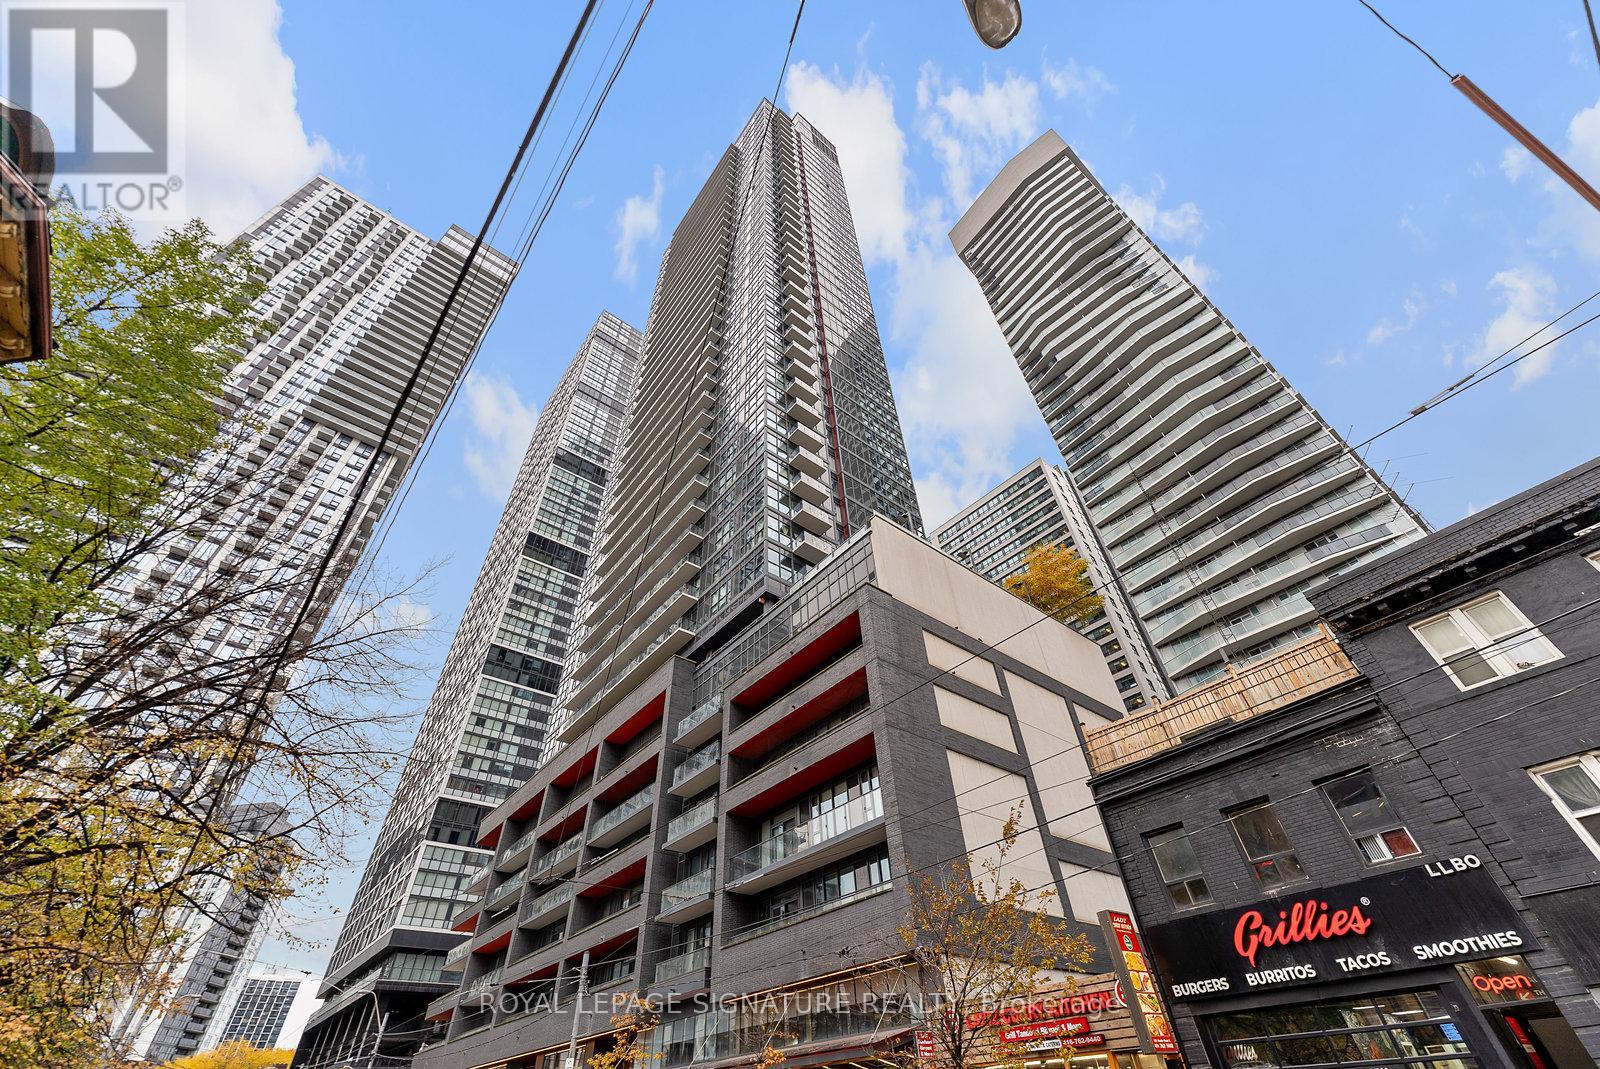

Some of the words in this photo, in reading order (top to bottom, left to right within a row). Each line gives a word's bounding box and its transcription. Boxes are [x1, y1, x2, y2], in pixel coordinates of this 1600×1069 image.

[1425, 854, 1481, 877] LLBO
[1171, 977, 1230, 997] BURGERS
[1245, 964, 1317, 986] BURRITOS
[1336, 951, 1392, 972] TACOS
[1412, 930, 1523, 960] SMOOTHIES
[1471, 974, 1532, 994] Open
